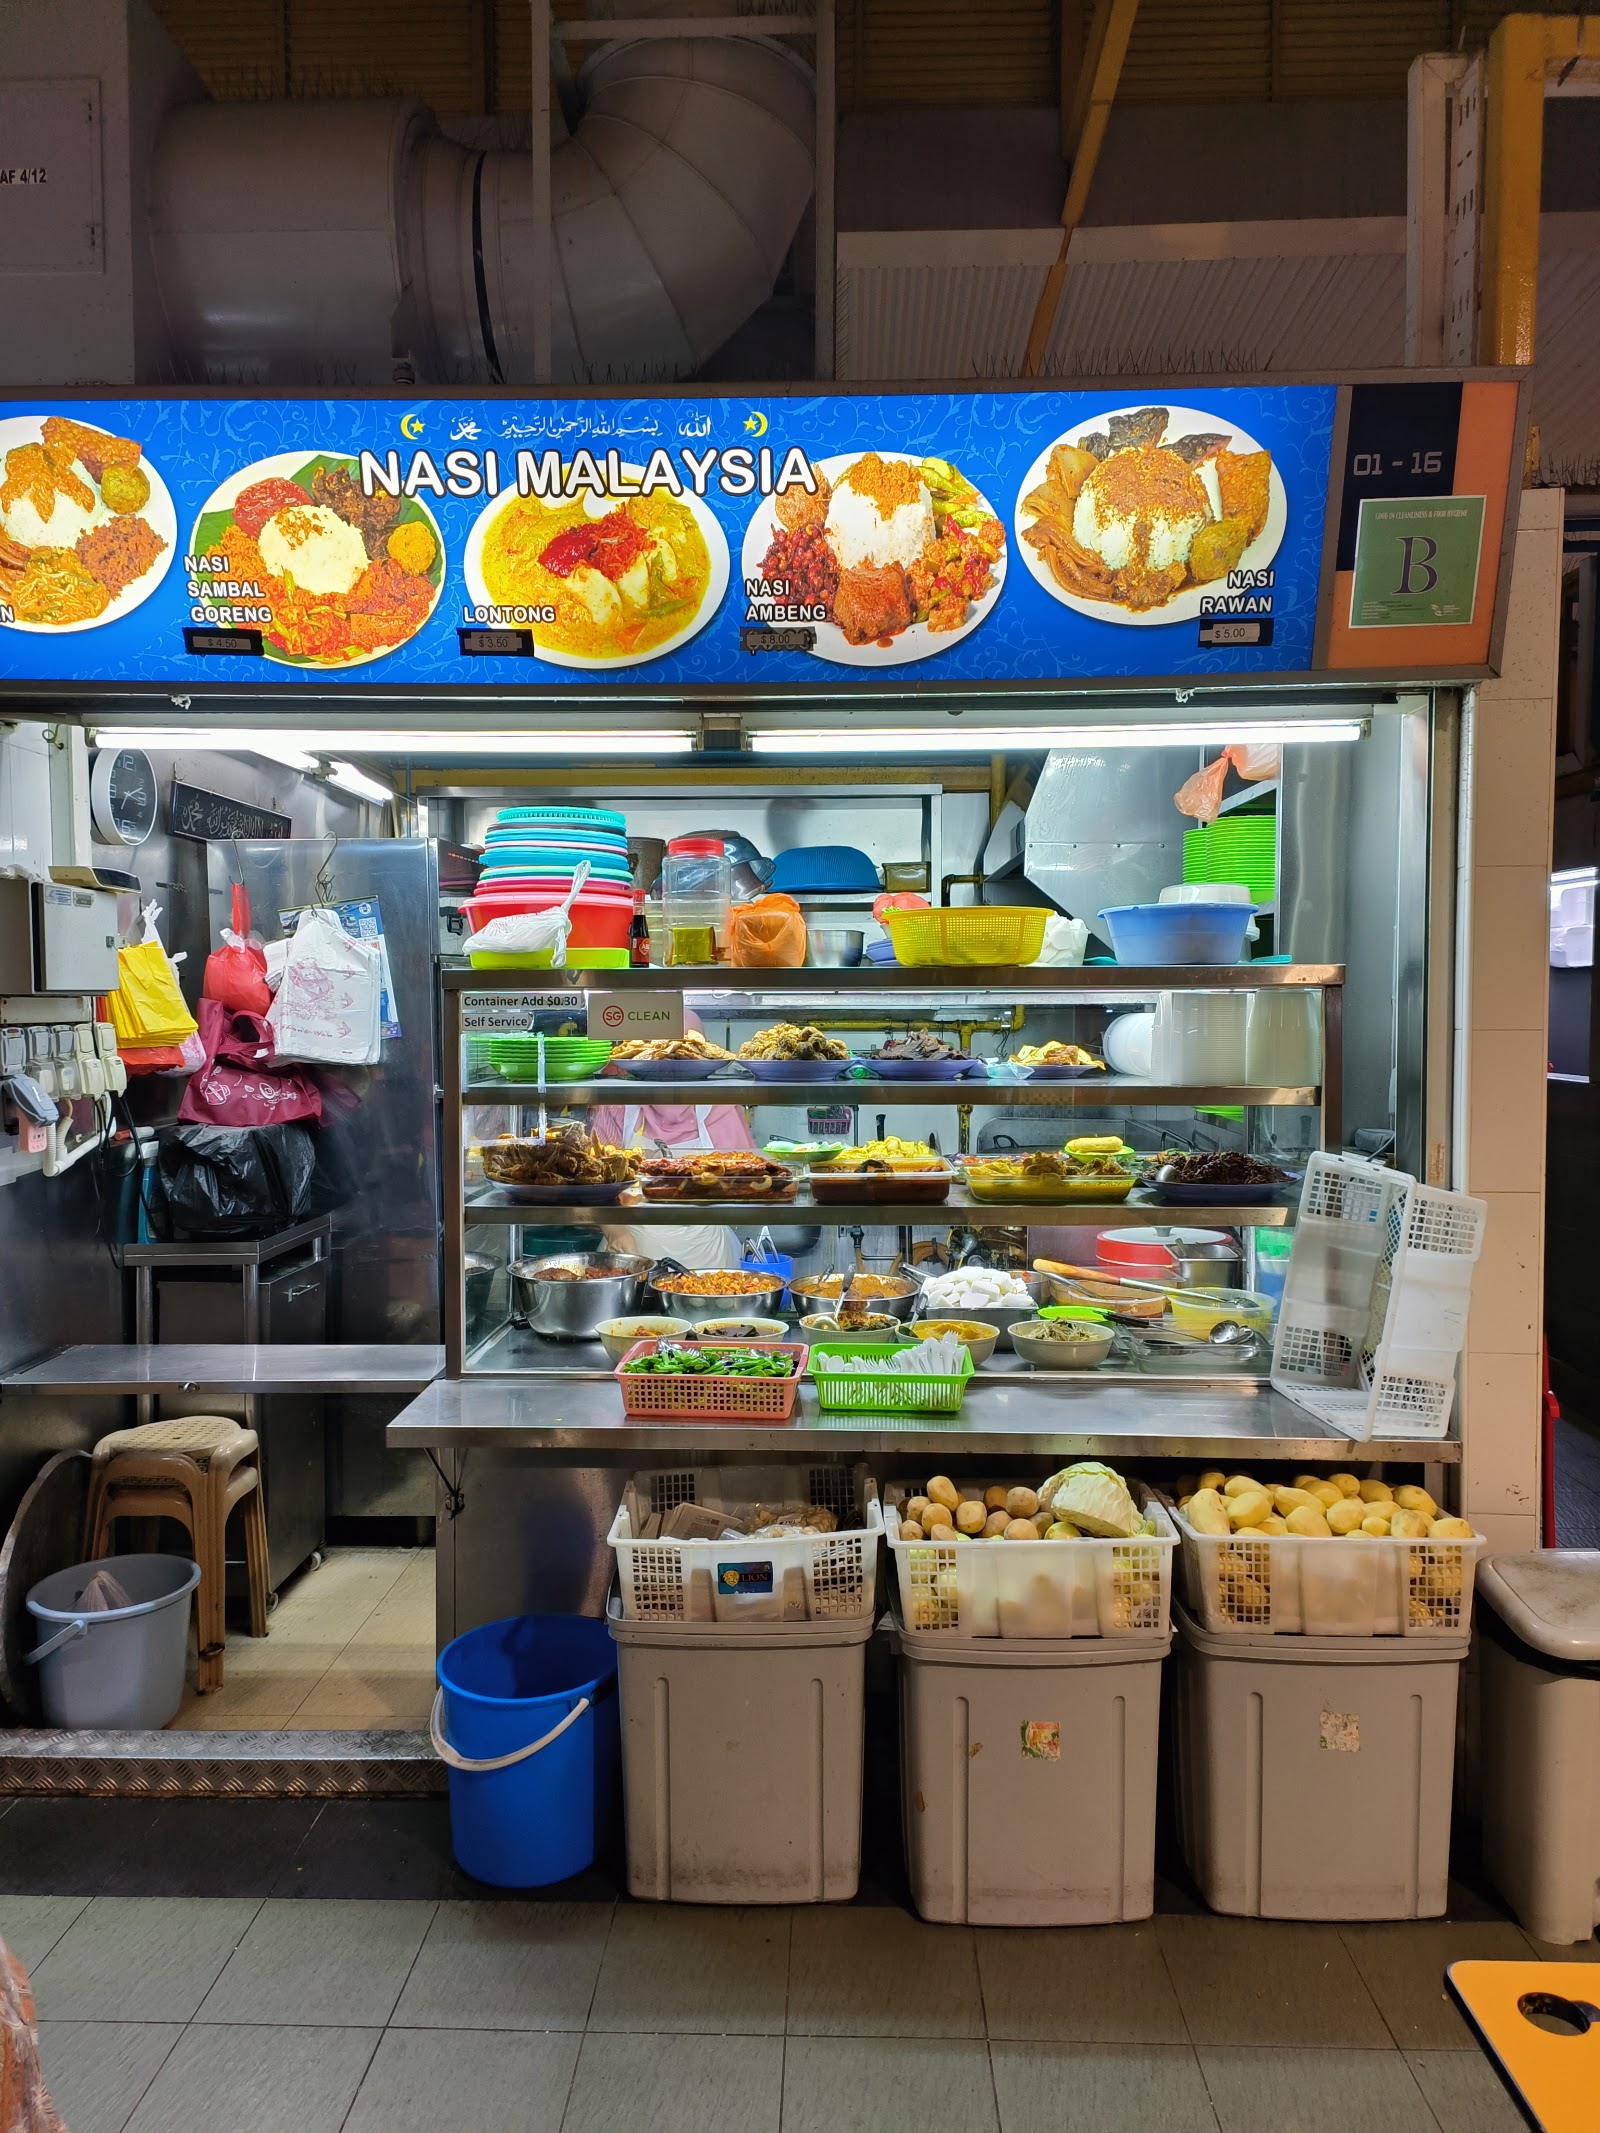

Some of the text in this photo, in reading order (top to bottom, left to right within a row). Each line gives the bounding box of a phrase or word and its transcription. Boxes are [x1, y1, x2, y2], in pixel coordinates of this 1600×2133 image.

[0, 168, 47, 185] AF 4/12
[359, 446, 819, 498] NASI MALAYSIA
[1353, 453, 1383, 476] 01
[1411, 451, 1443, 474] 16
[183, 554, 229, 574] NASI
[1390, 536, 1439, 596] B
[745, 578, 790, 597] NASI
[1227, 569, 1275, 589] NASI
[187, 579, 266, 599] SAMBAL
[190, 605, 272, 623] GORENG
[463, 605, 556, 623] LONTONG
[745, 603, 827, 622] AMBENG
[1200, 595, 1273, 615] RAWAN
[769, 634, 790, 645] 8.00
[1223, 627, 1246, 639] 5.00
[216, 637, 238, 649] 4.50
[487, 638, 508, 648] 3.50
[464, 995, 578, 1008] Container Add $0.30
[464, 1016, 528, 1028] Self Service
[627, 1010, 671, 1022] CLEAN
[741, 1573, 768, 1582] LION
